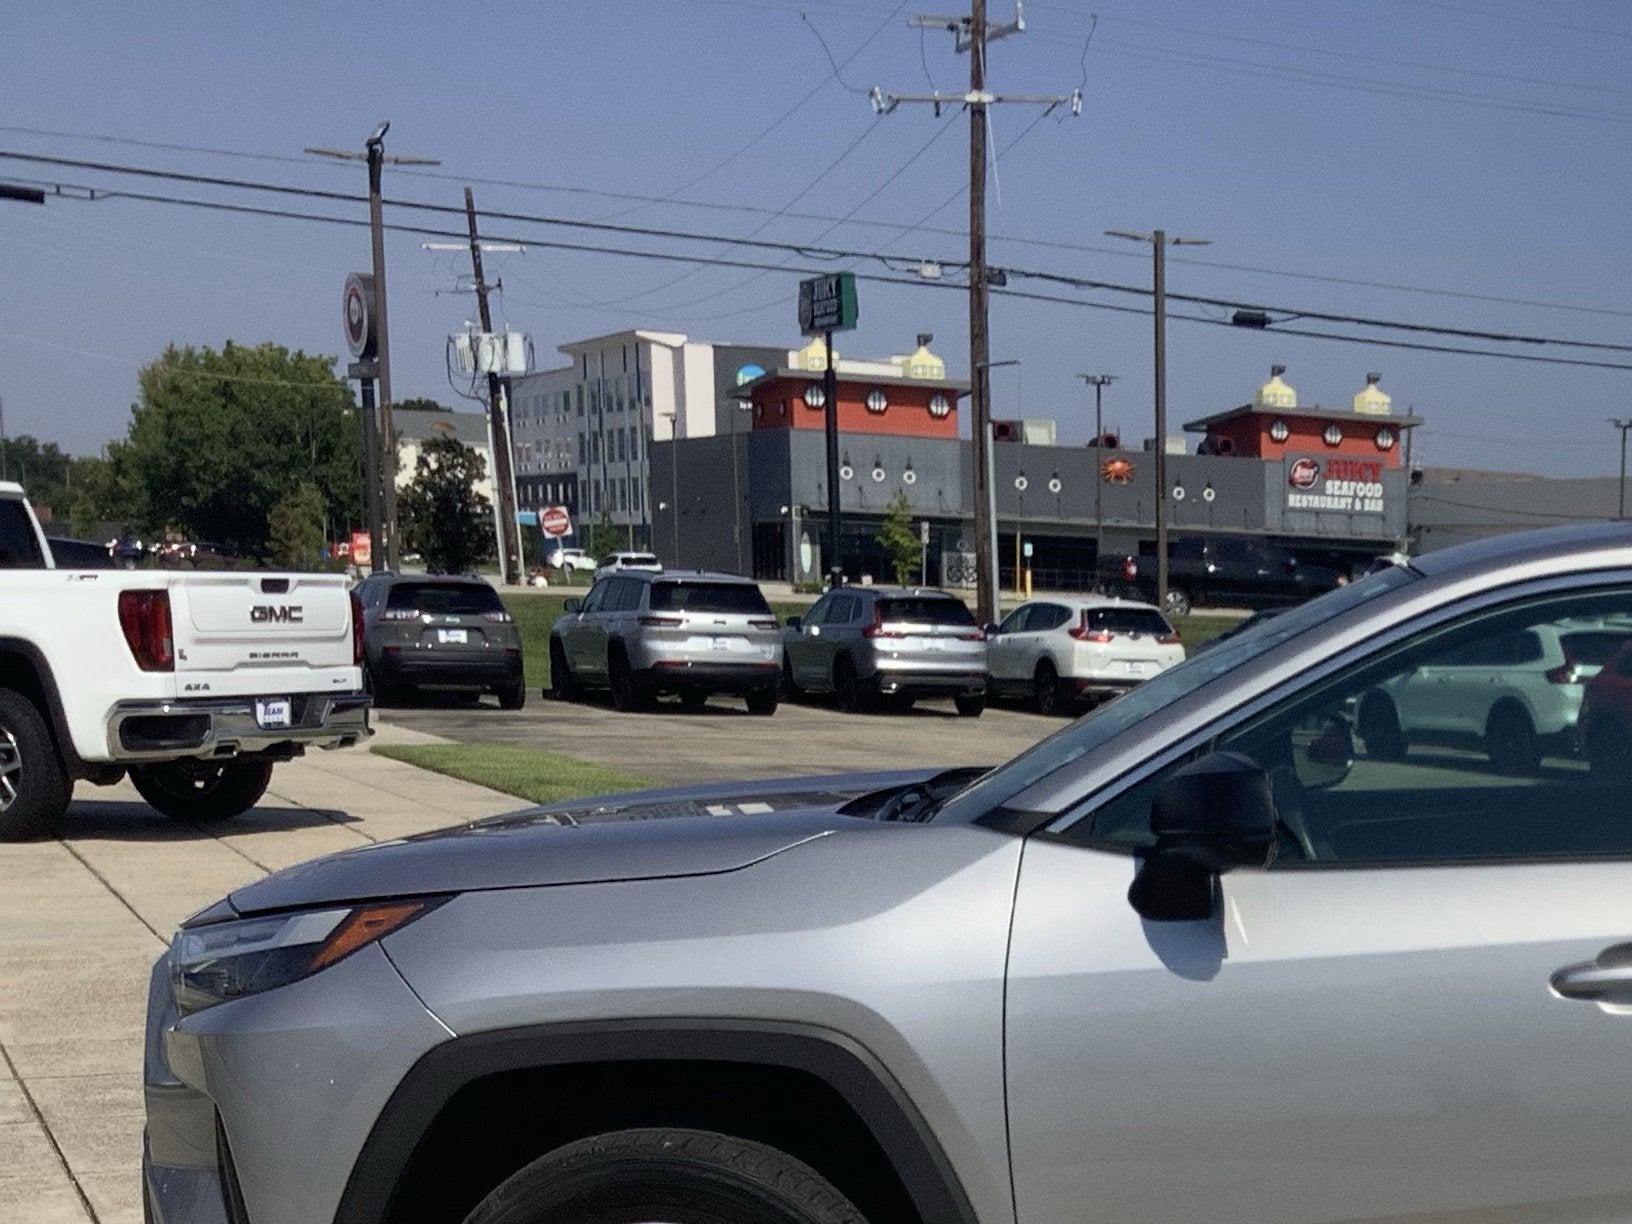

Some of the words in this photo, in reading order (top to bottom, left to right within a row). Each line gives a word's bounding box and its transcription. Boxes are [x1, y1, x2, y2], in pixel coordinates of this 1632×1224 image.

[1325, 480, 1383, 497] SEAFOOD
[1288, 494, 1352, 509] RESTAURANT
[1364, 498, 1384, 512] BAR
[250, 606, 303, 623] GMC
